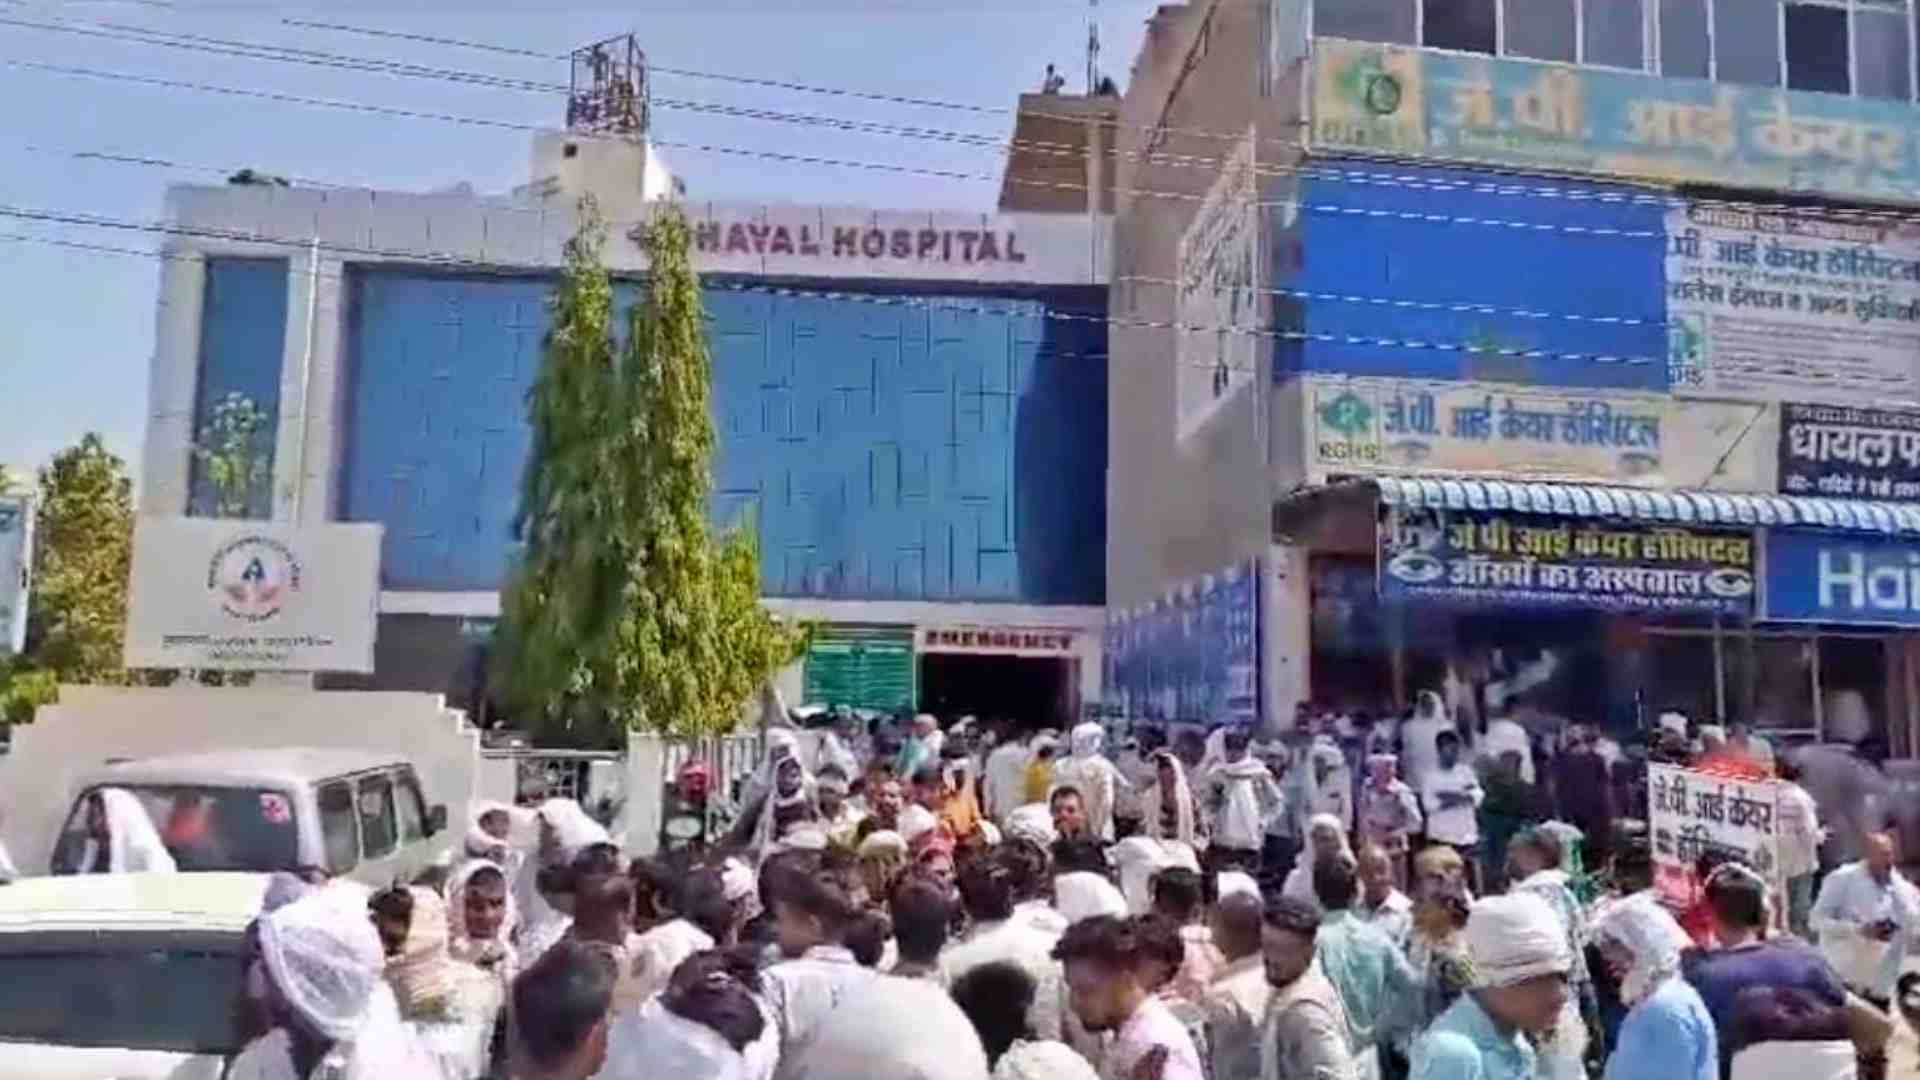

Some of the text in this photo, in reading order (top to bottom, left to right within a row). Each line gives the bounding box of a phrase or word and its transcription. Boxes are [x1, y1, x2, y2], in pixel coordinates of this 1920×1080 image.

[832, 226, 1026, 263] HOSPITAL
[1583, 566, 1699, 595] अस्पताल
[926, 631, 1073, 650] EMERGENCY
